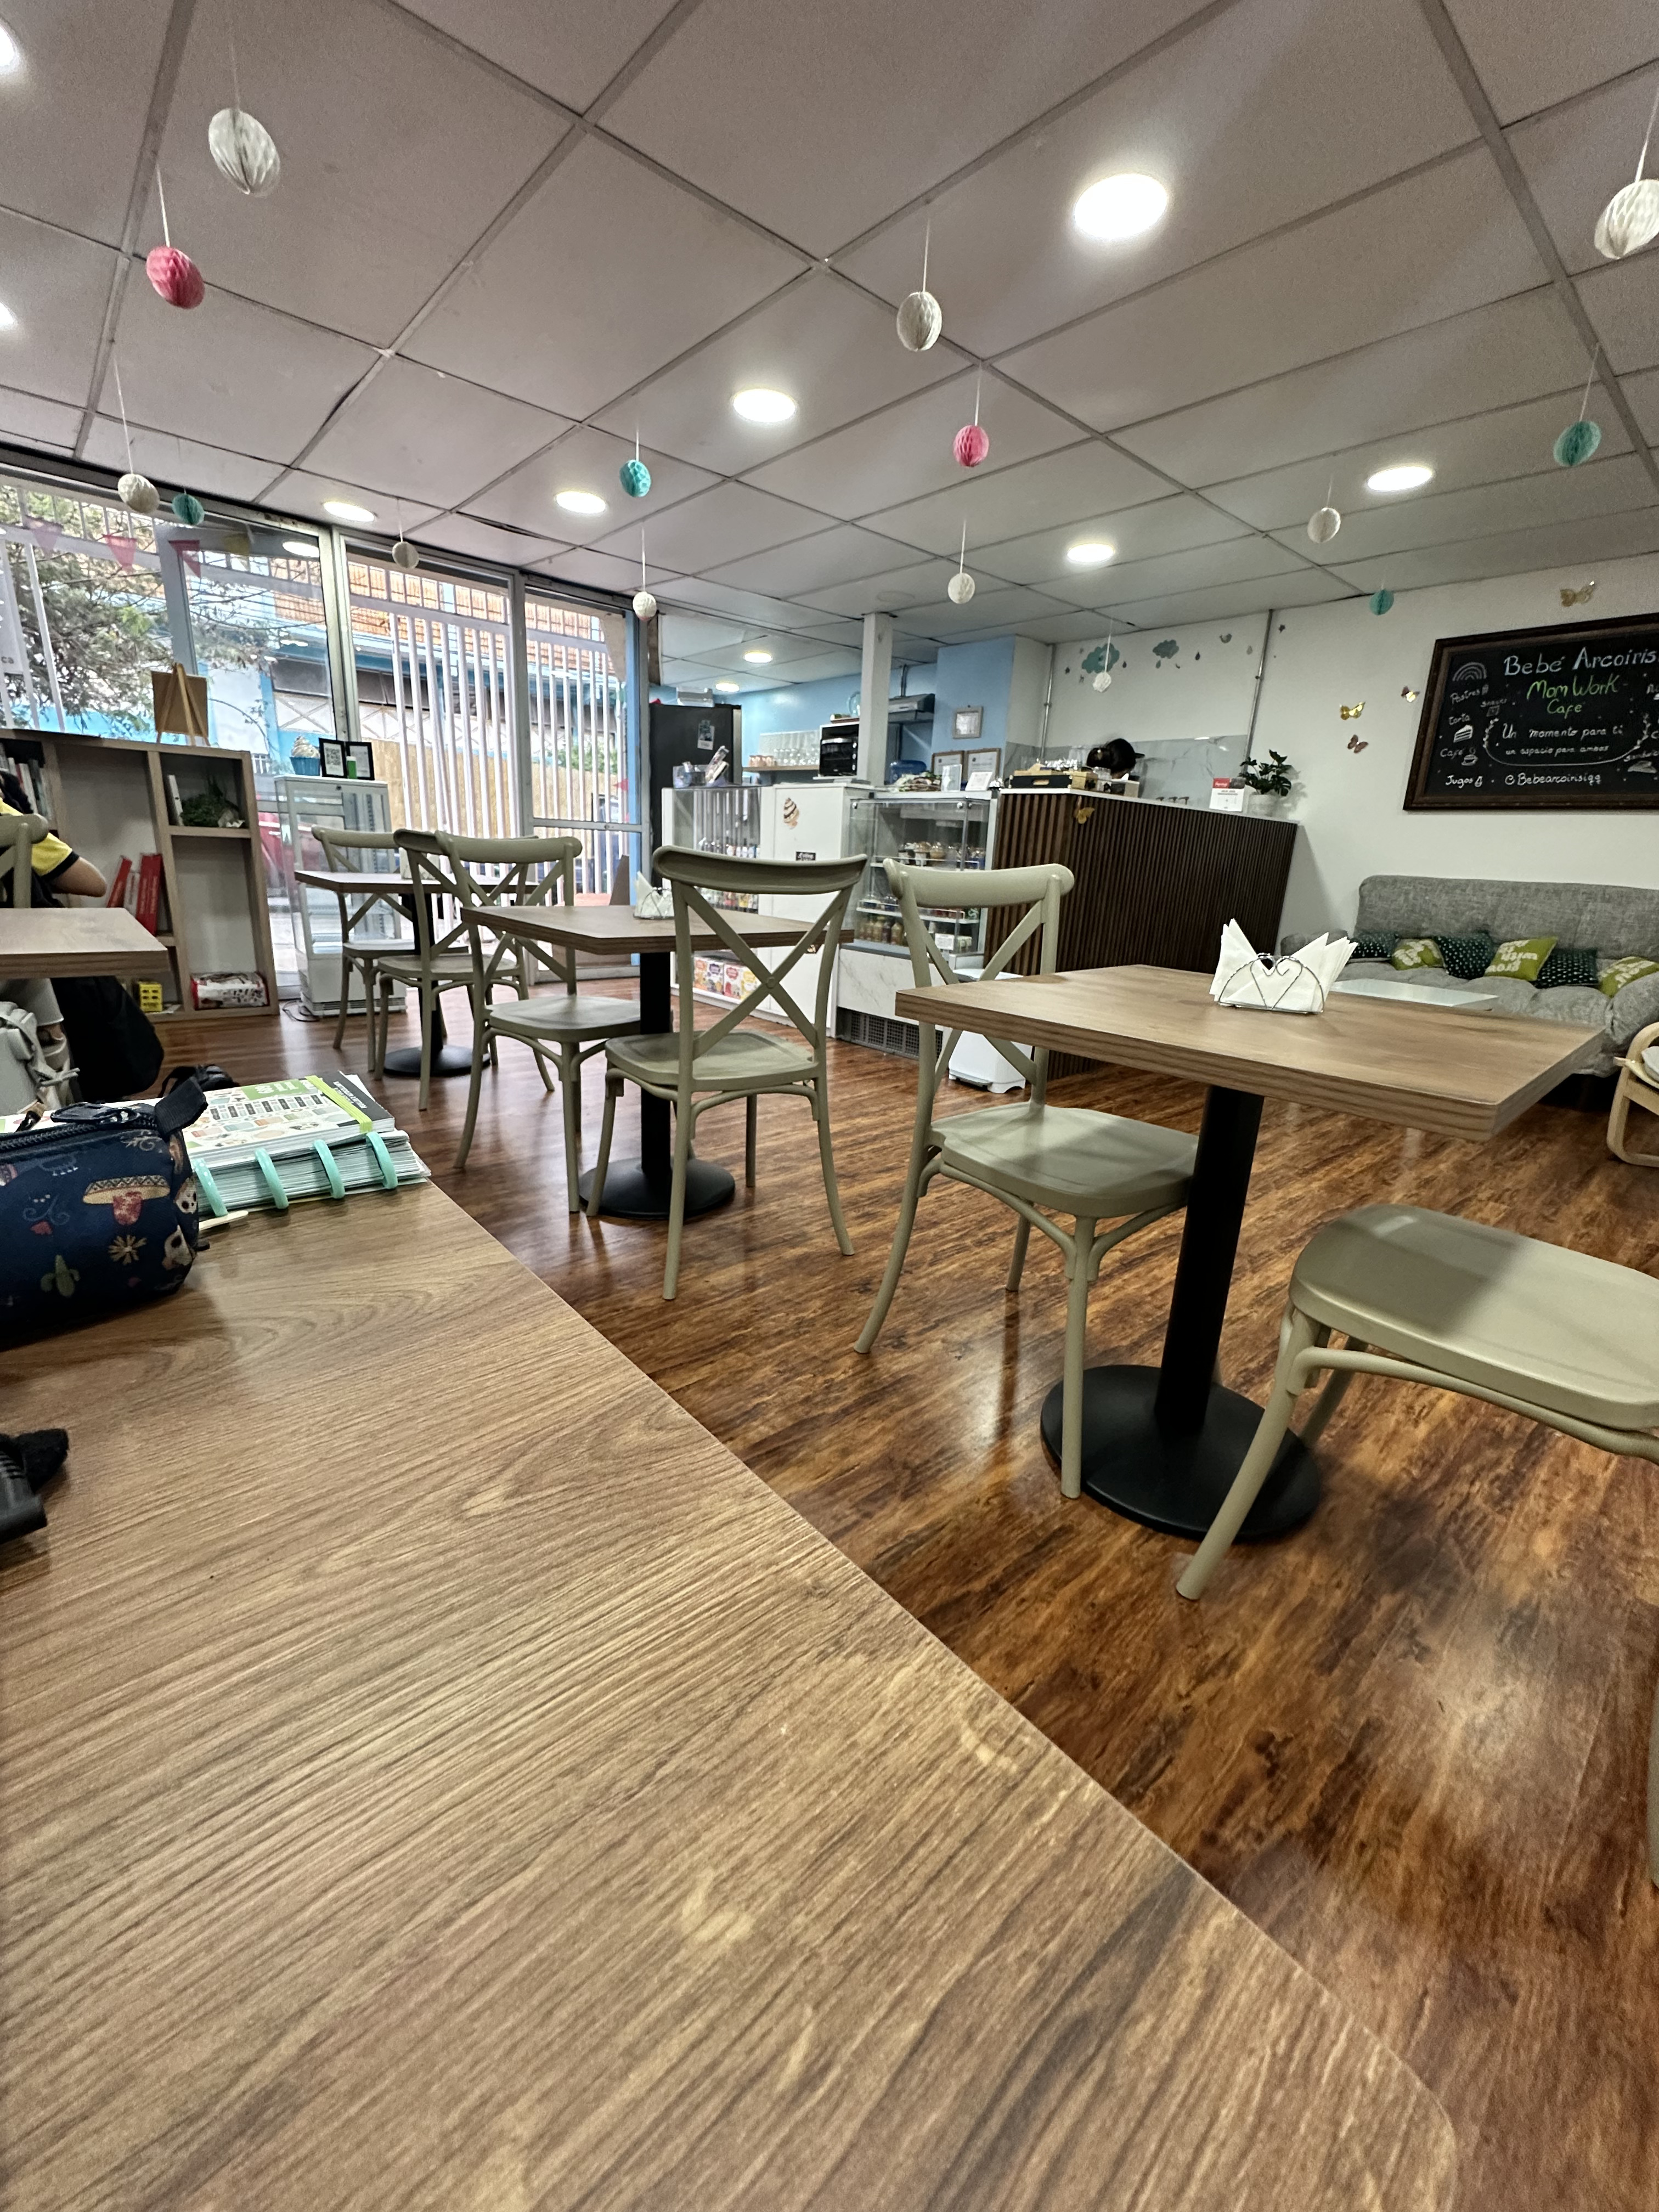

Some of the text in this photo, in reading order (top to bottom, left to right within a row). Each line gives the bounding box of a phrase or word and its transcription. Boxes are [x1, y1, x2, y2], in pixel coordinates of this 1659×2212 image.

[1526, 679, 1568, 700] Mom
[1503, 723, 1517, 740] Un
[1528, 726, 1578, 738] momento
[1581, 728, 1606, 740] para
[1444, 774, 1474, 789] Jugos
